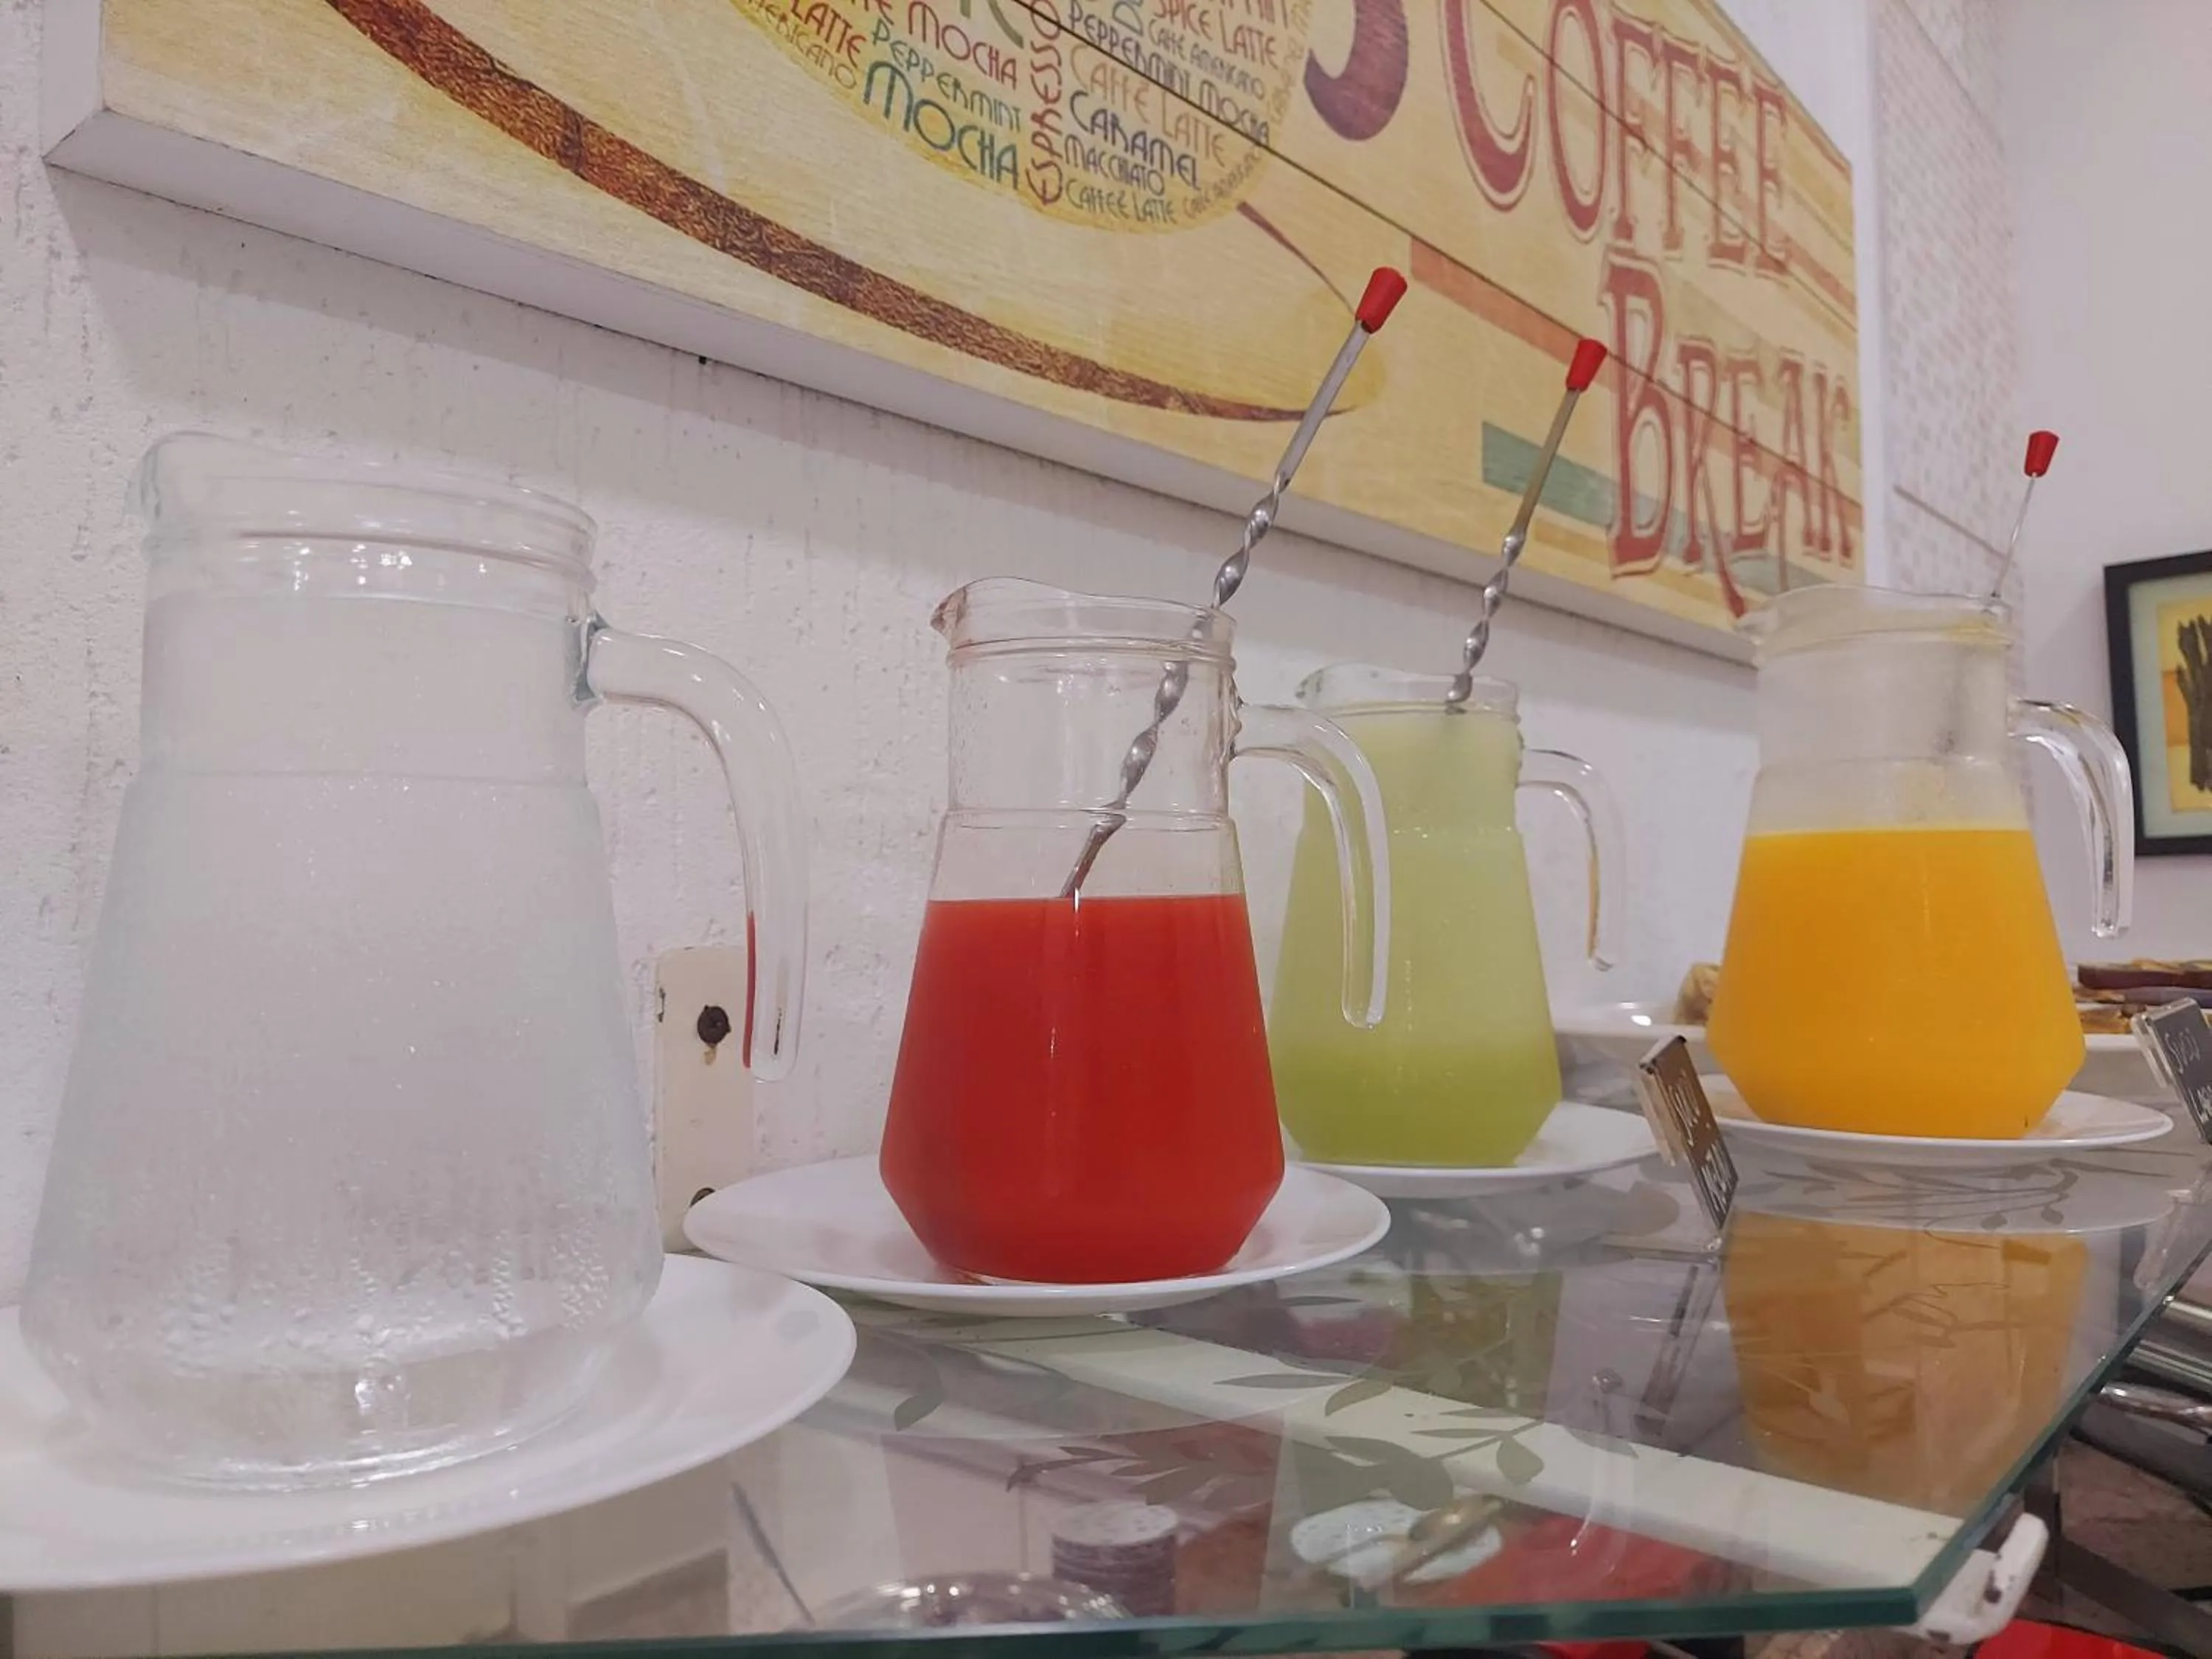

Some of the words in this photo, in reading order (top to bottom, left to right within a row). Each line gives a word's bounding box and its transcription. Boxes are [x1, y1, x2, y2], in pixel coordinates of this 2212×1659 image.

[872, 18, 1022, 133] PEPPERMINT
[909, 1, 1018, 90] MOCHA
[1068, 0, 1190, 100] PEPPERMINT
[1200, 80, 1270, 146] MOCHA
[1219, 9, 1279, 70] LATTE
[863, 60, 1019, 190] MOCHA
[1026, 0, 1063, 205] ESPRESSO
[1070, 90, 1202, 191] CARAMEL
[1161, 90, 1225, 167] LATTE
[1440, 0, 1792, 287] COFFEE
[1065, 134, 1165, 196] MACCHIATO
[1599, 244, 1856, 618] BREAK
